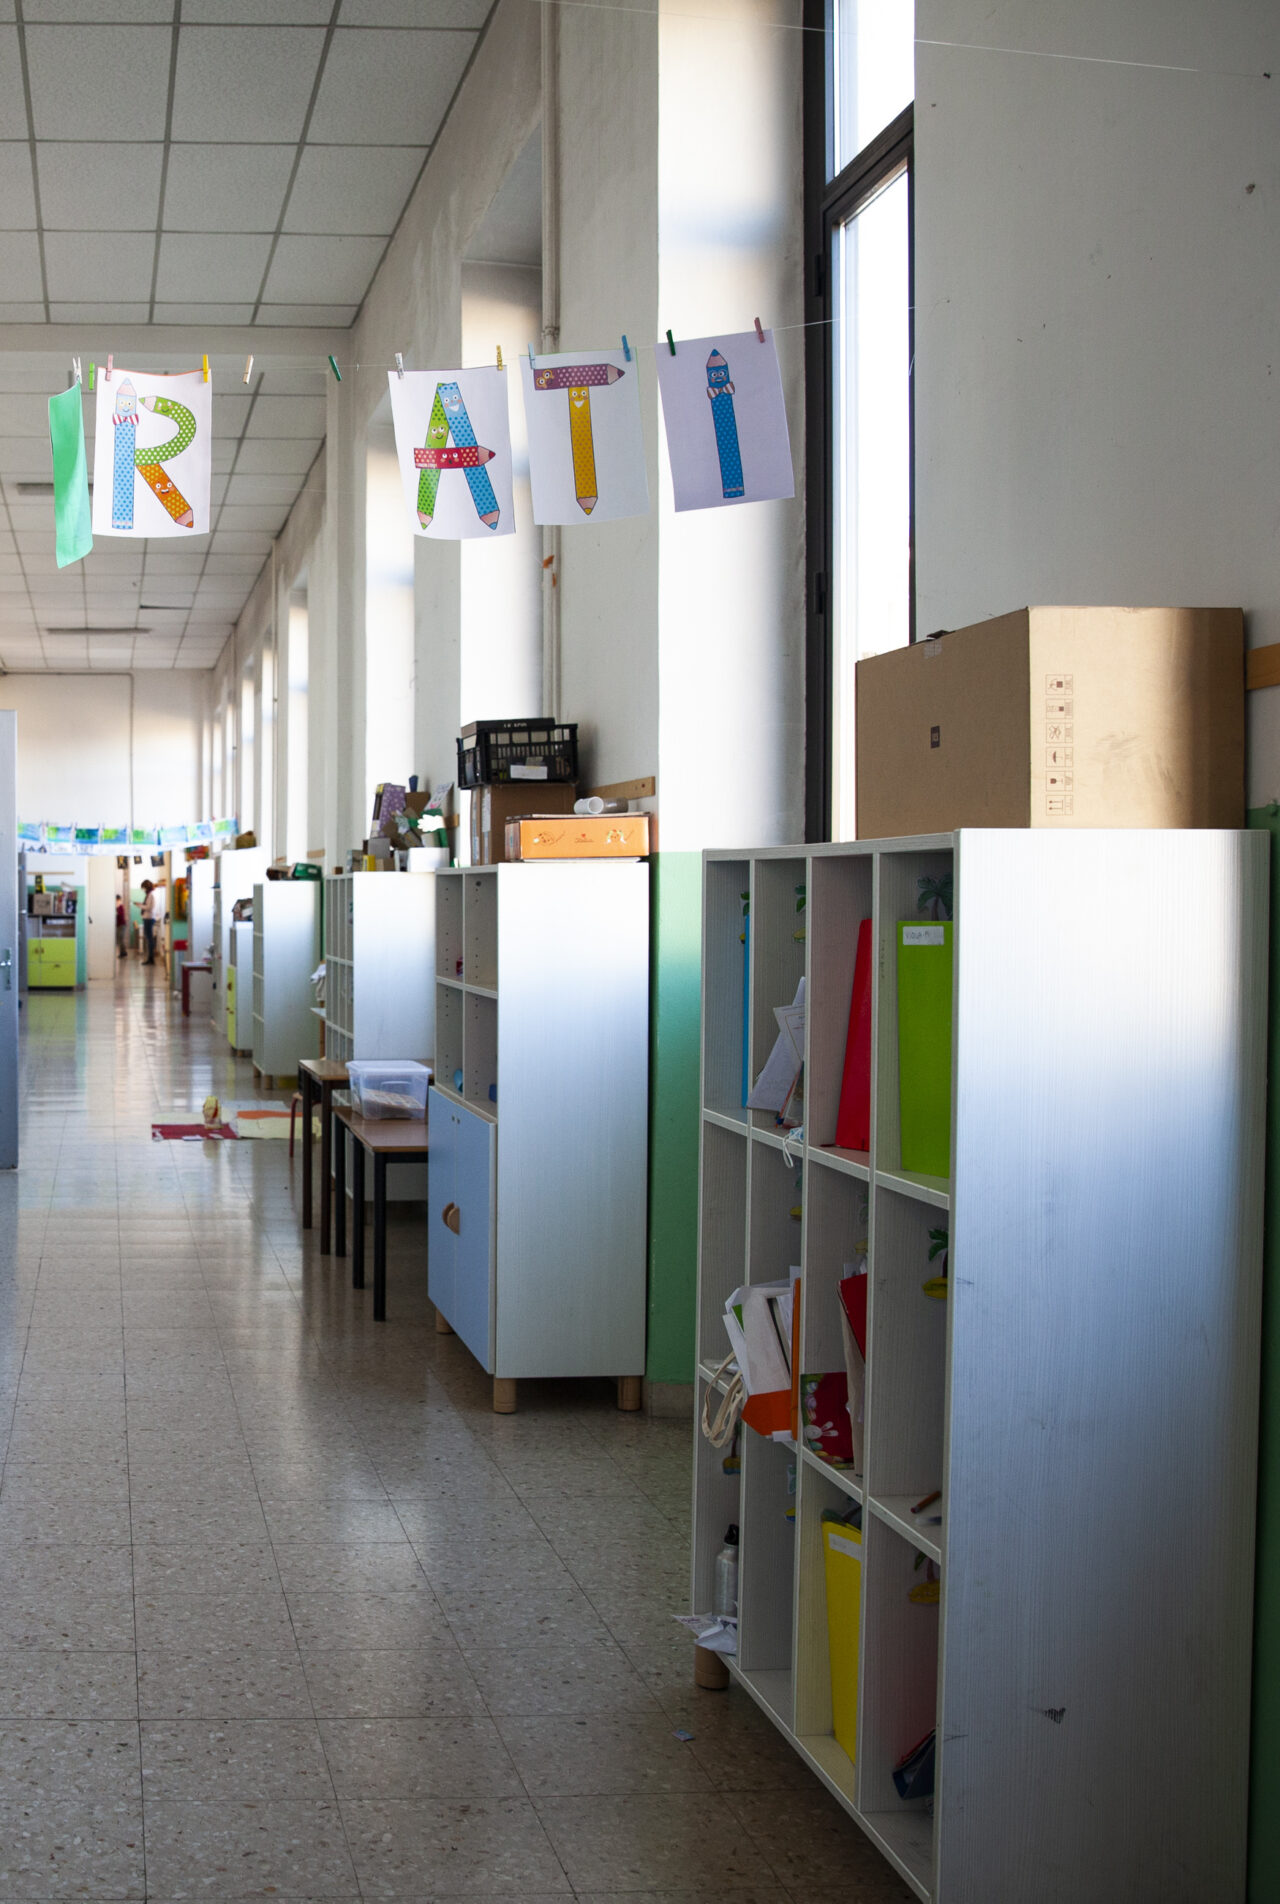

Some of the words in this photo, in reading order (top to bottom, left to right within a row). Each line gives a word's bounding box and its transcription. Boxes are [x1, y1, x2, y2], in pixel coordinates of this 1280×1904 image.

[111, 378, 198, 529] R
[414, 382, 500, 531] A
[533, 363, 626, 516] T
[707, 348, 745, 499] I
